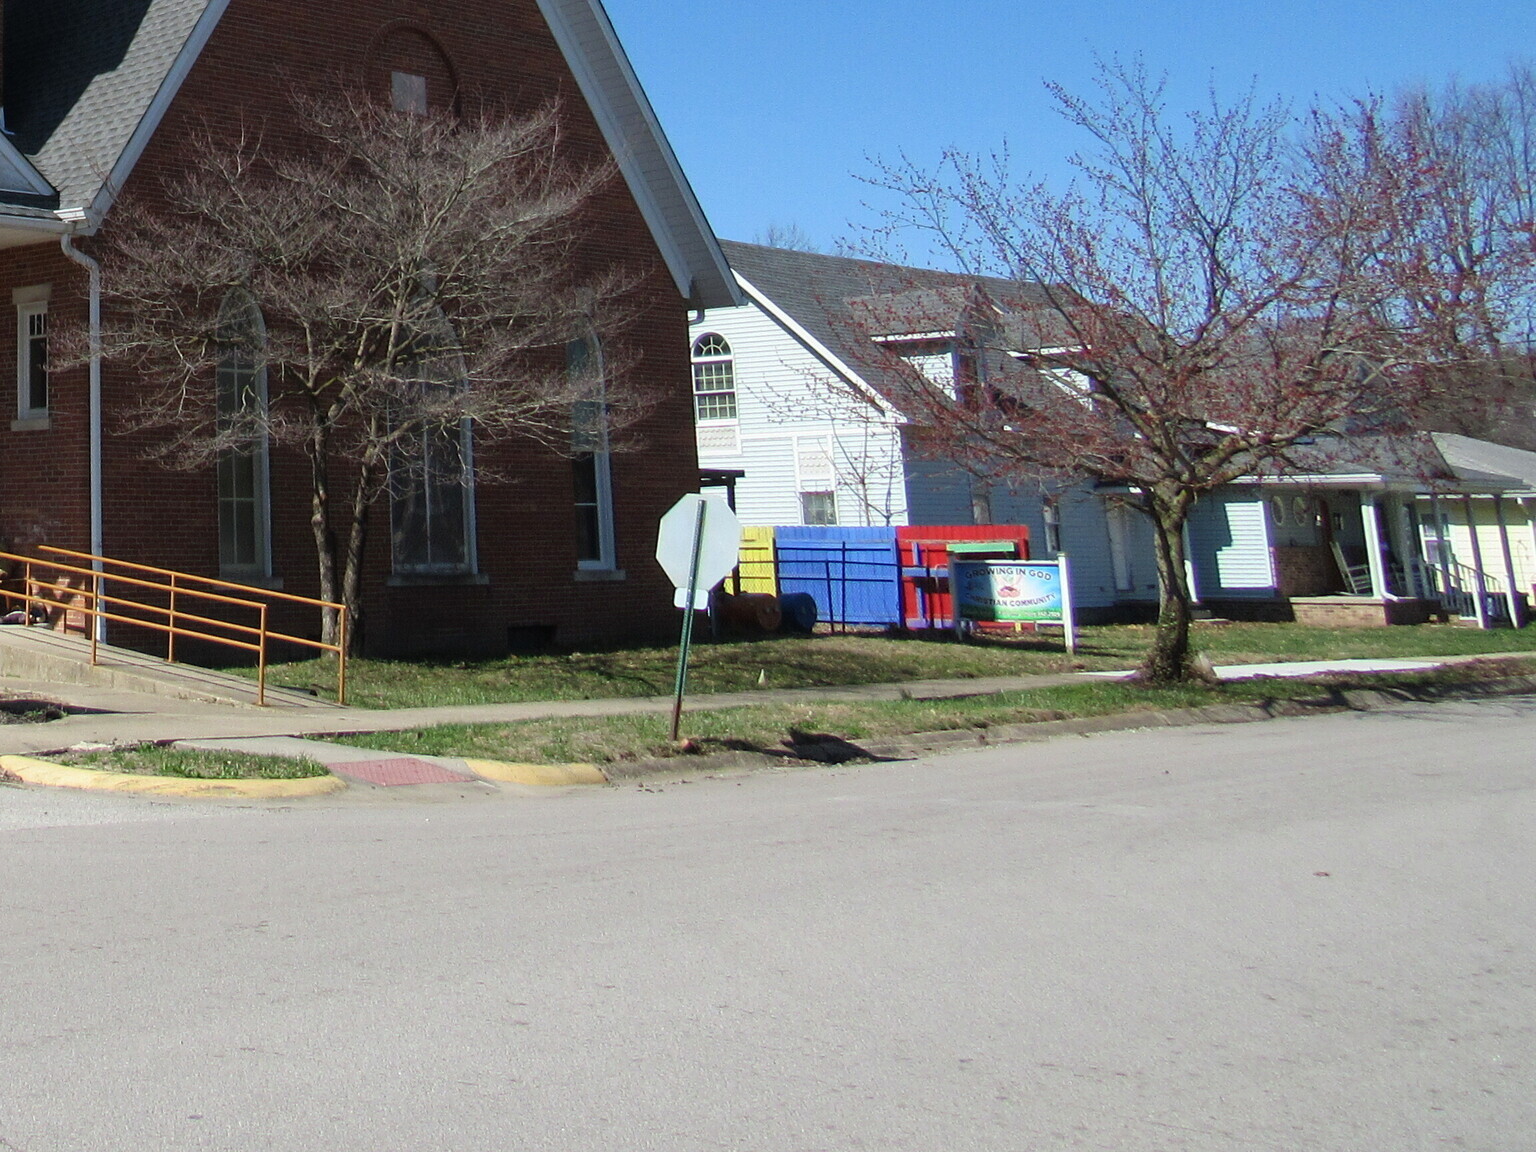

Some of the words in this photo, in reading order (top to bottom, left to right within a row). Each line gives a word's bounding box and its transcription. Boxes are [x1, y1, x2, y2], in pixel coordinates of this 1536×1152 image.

[965, 567, 1013, 579] GROWING
[1028, 569, 1052, 581] GOD
[1010, 593, 1056, 607] COMMUNITY
